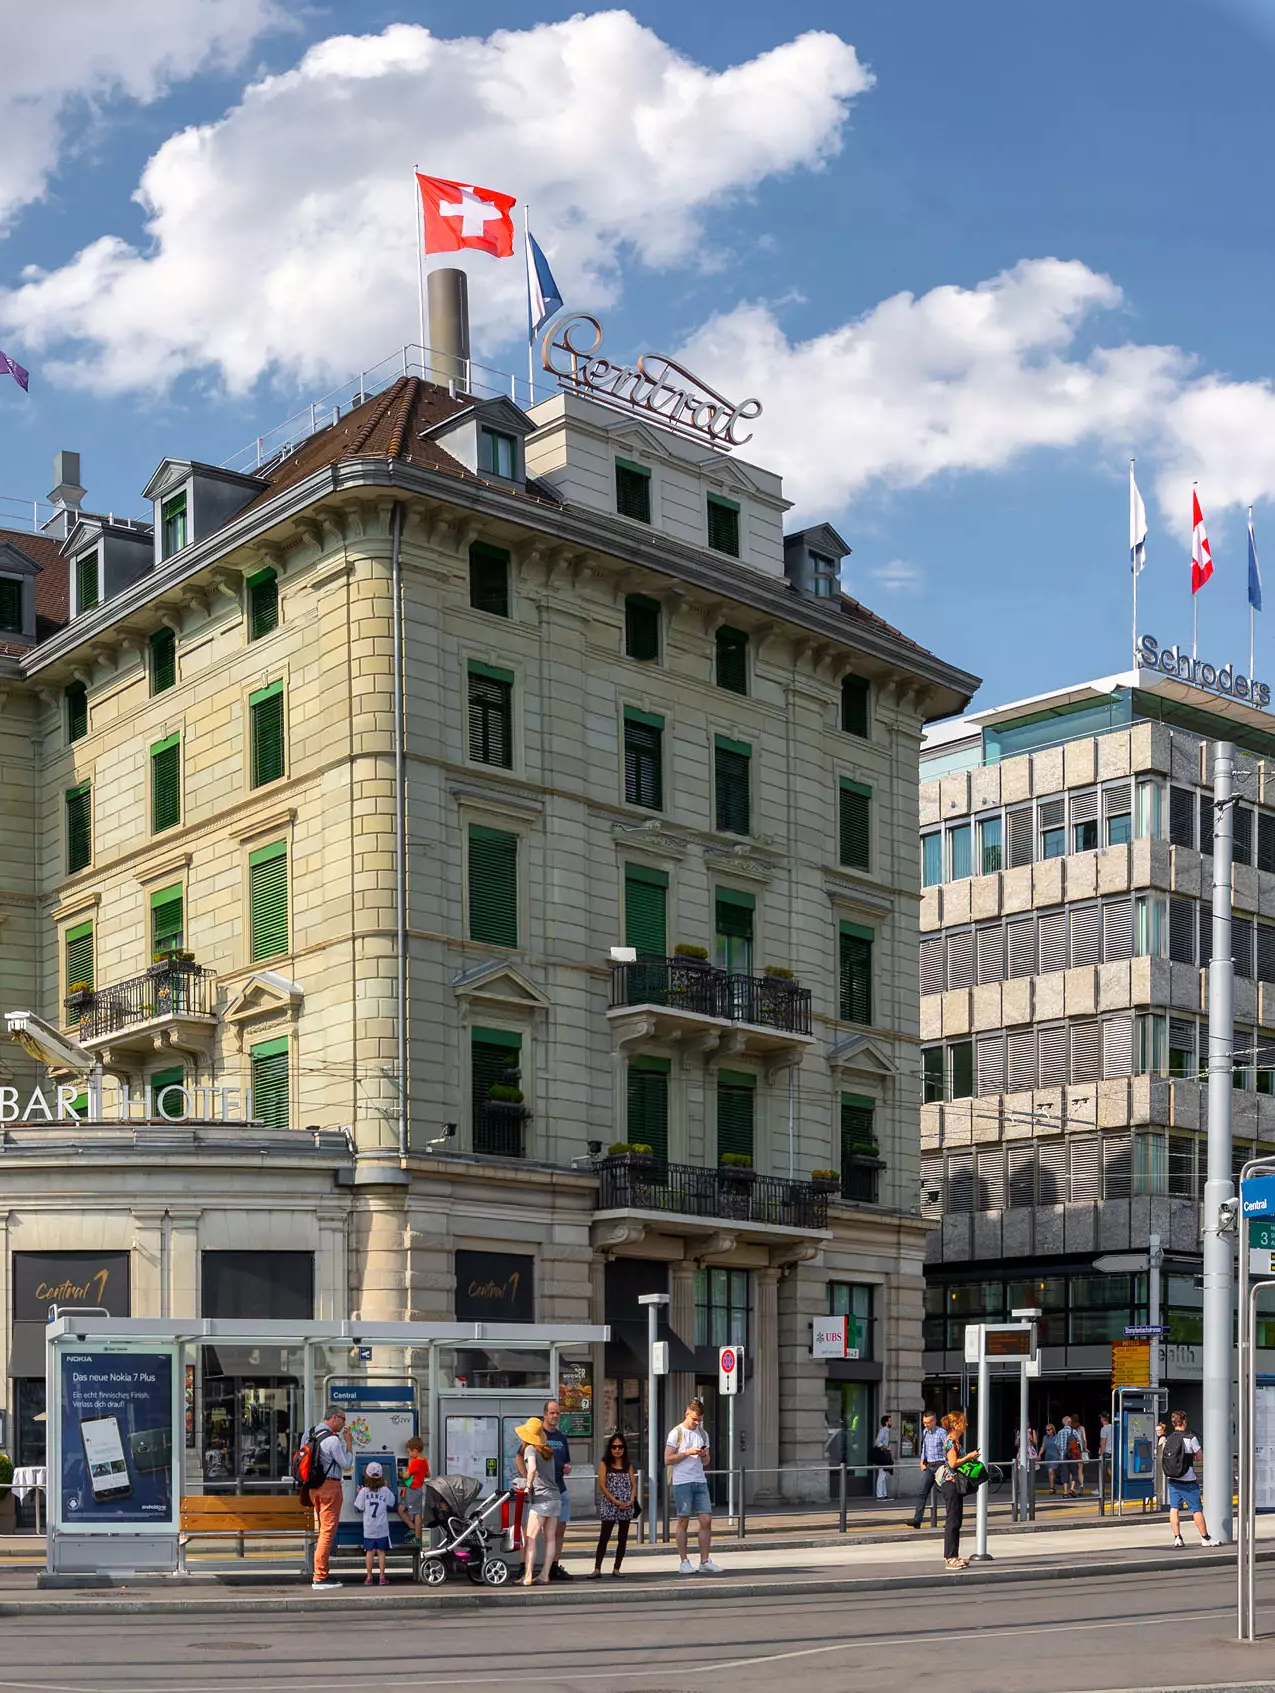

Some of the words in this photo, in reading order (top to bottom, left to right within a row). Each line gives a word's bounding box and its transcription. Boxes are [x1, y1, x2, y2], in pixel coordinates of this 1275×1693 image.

[542, 312, 763, 446] Central
[1137, 634, 1271, 707] Schroders
[122, 1084, 264, 1124] HOTEL
[1244, 1199, 1267, 1212] Central
[1260, 1231, 1269, 1245] 3
[35, 1280, 91, 1300] Central
[825, 1332, 842, 1342] UBS
[1157, 1345, 1195, 1362] ealth
[72, 1372, 88, 1382] Das
[89, 1374, 109, 1382] neue
[110, 1372, 132, 1382] Nokia
[133, 1373, 139, 1382] 7
[140, 1372, 156, 1382] Plus
[72, 1391, 83, 1399] Ein
[84, 1391, 98, 1399] echt
[98, 1391, 130, 1400] finnisches
[369, 1502, 379, 1518] 7
